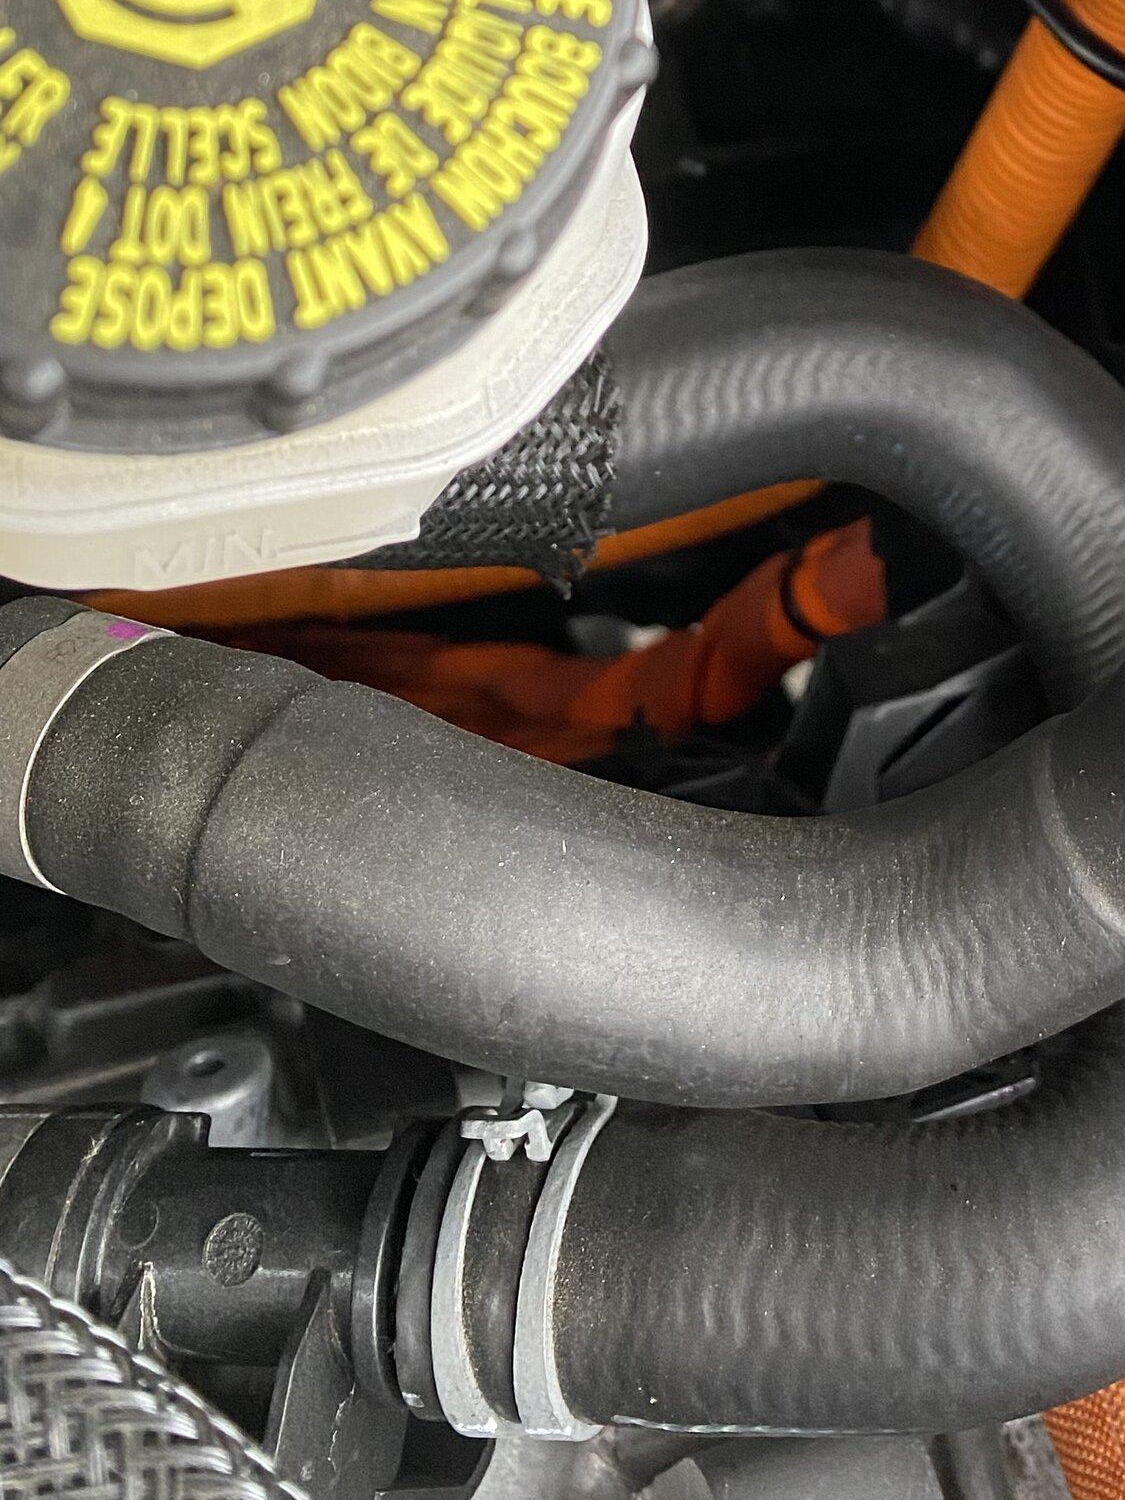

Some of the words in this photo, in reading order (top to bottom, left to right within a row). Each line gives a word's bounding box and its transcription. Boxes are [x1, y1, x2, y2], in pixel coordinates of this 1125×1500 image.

[278, 20, 424, 153] BIDON
[431, 24, 601, 232] BOUCHON
[81, 94, 283, 187] SCELLE
[351, 110, 440, 198] DE
[109, 185, 212, 267] DOT
[222, 148, 374, 258] FREIN
[50, 254, 276, 352] DEPOSE
[286, 192, 450, 329] AVANT
[133, 526, 275, 581] MIN
